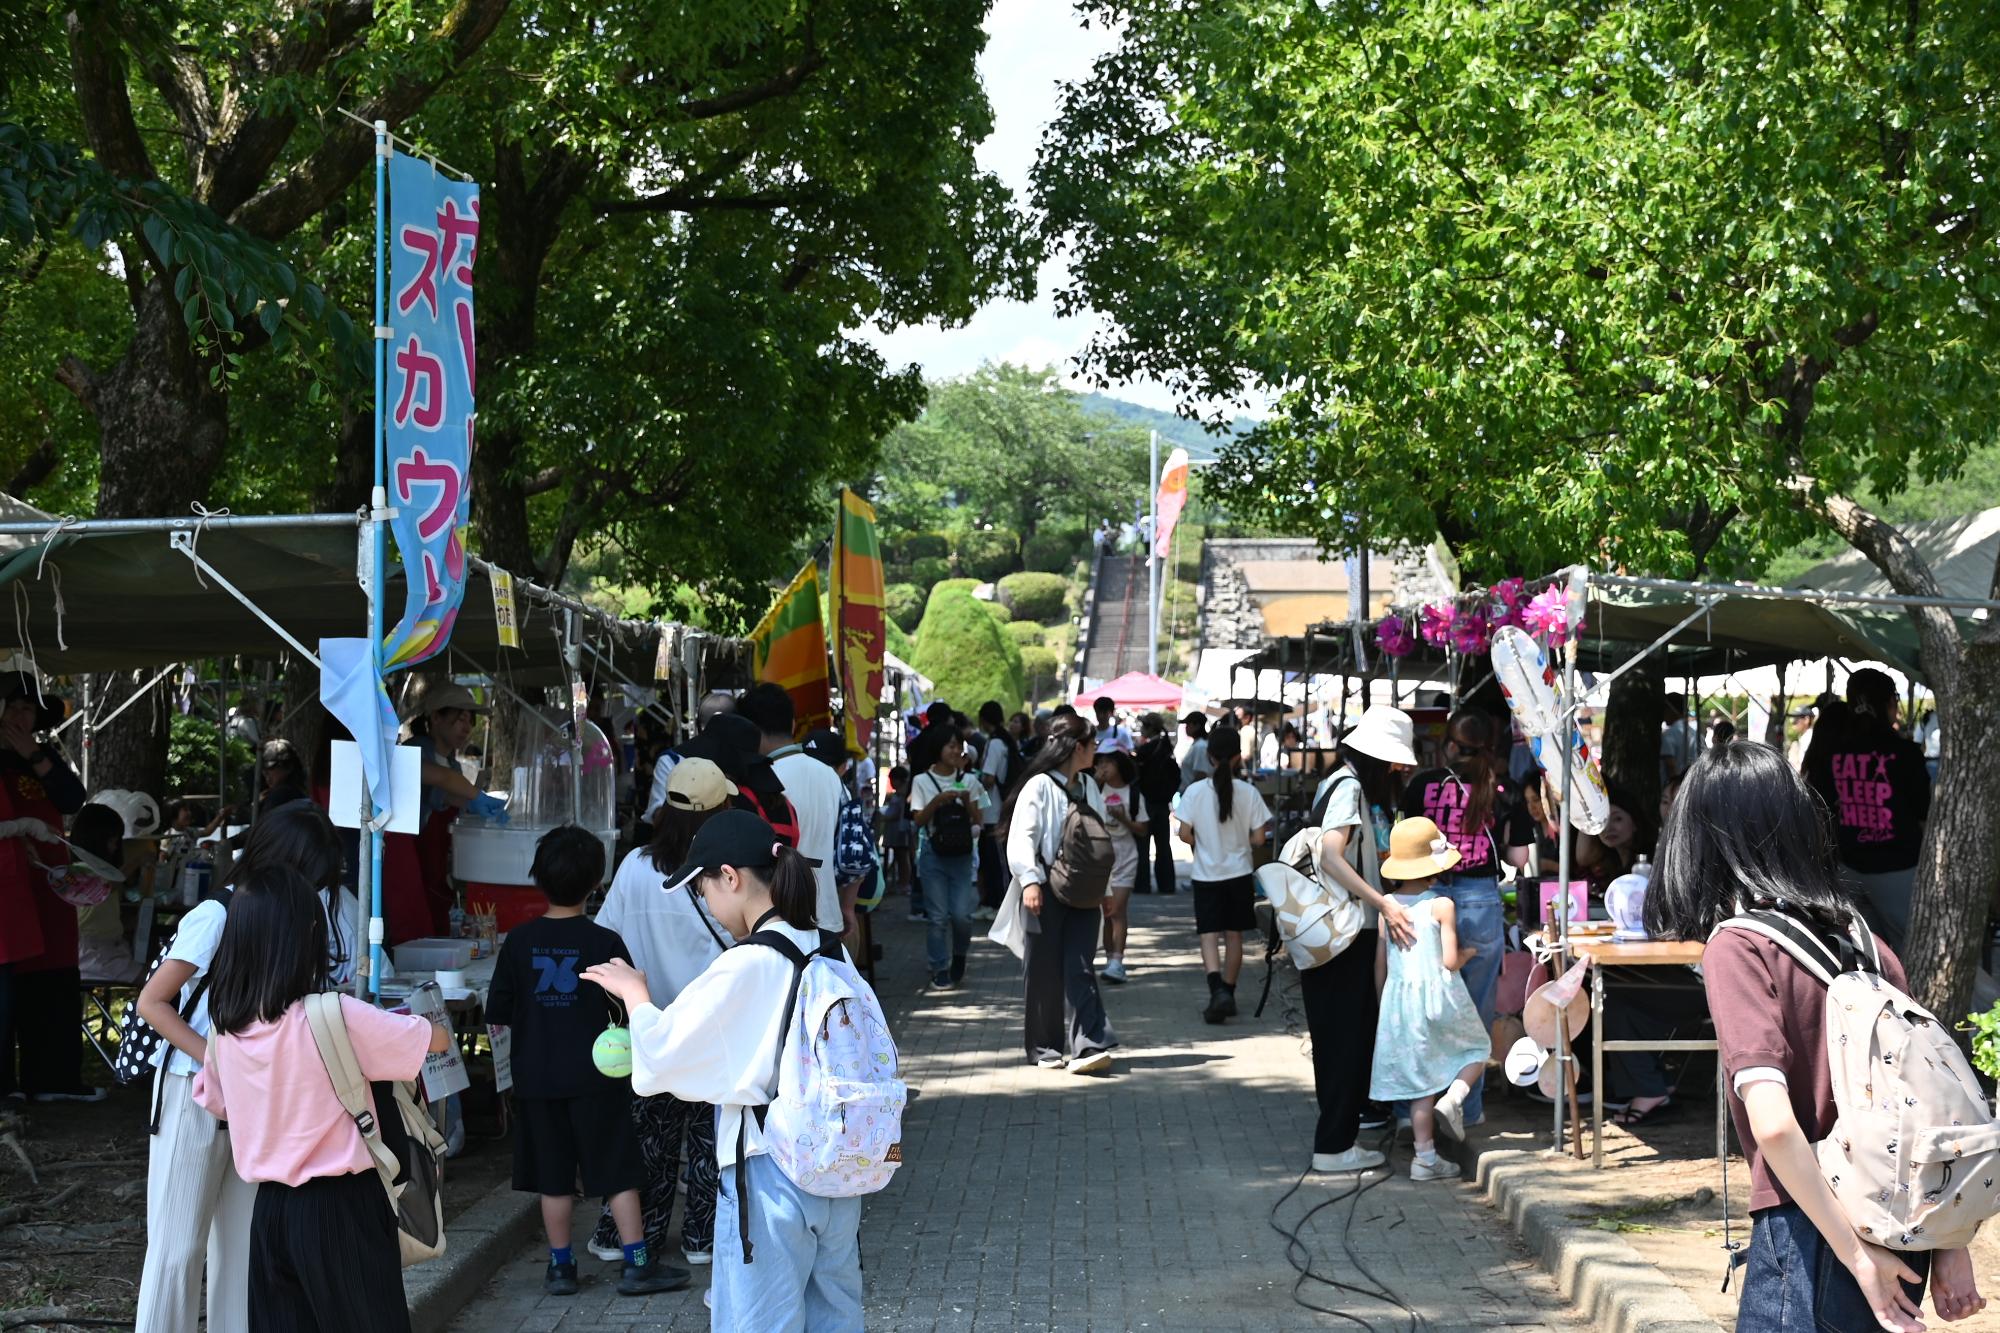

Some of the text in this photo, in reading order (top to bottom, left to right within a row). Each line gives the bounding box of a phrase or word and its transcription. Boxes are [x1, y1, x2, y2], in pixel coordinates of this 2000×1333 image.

[1832, 753, 1871, 780] EAT
[1423, 782, 1473, 808] EAT
[1840, 803, 1893, 830] HEER
[1448, 834, 1490, 861] EER
[532, 956, 579, 993] 76
